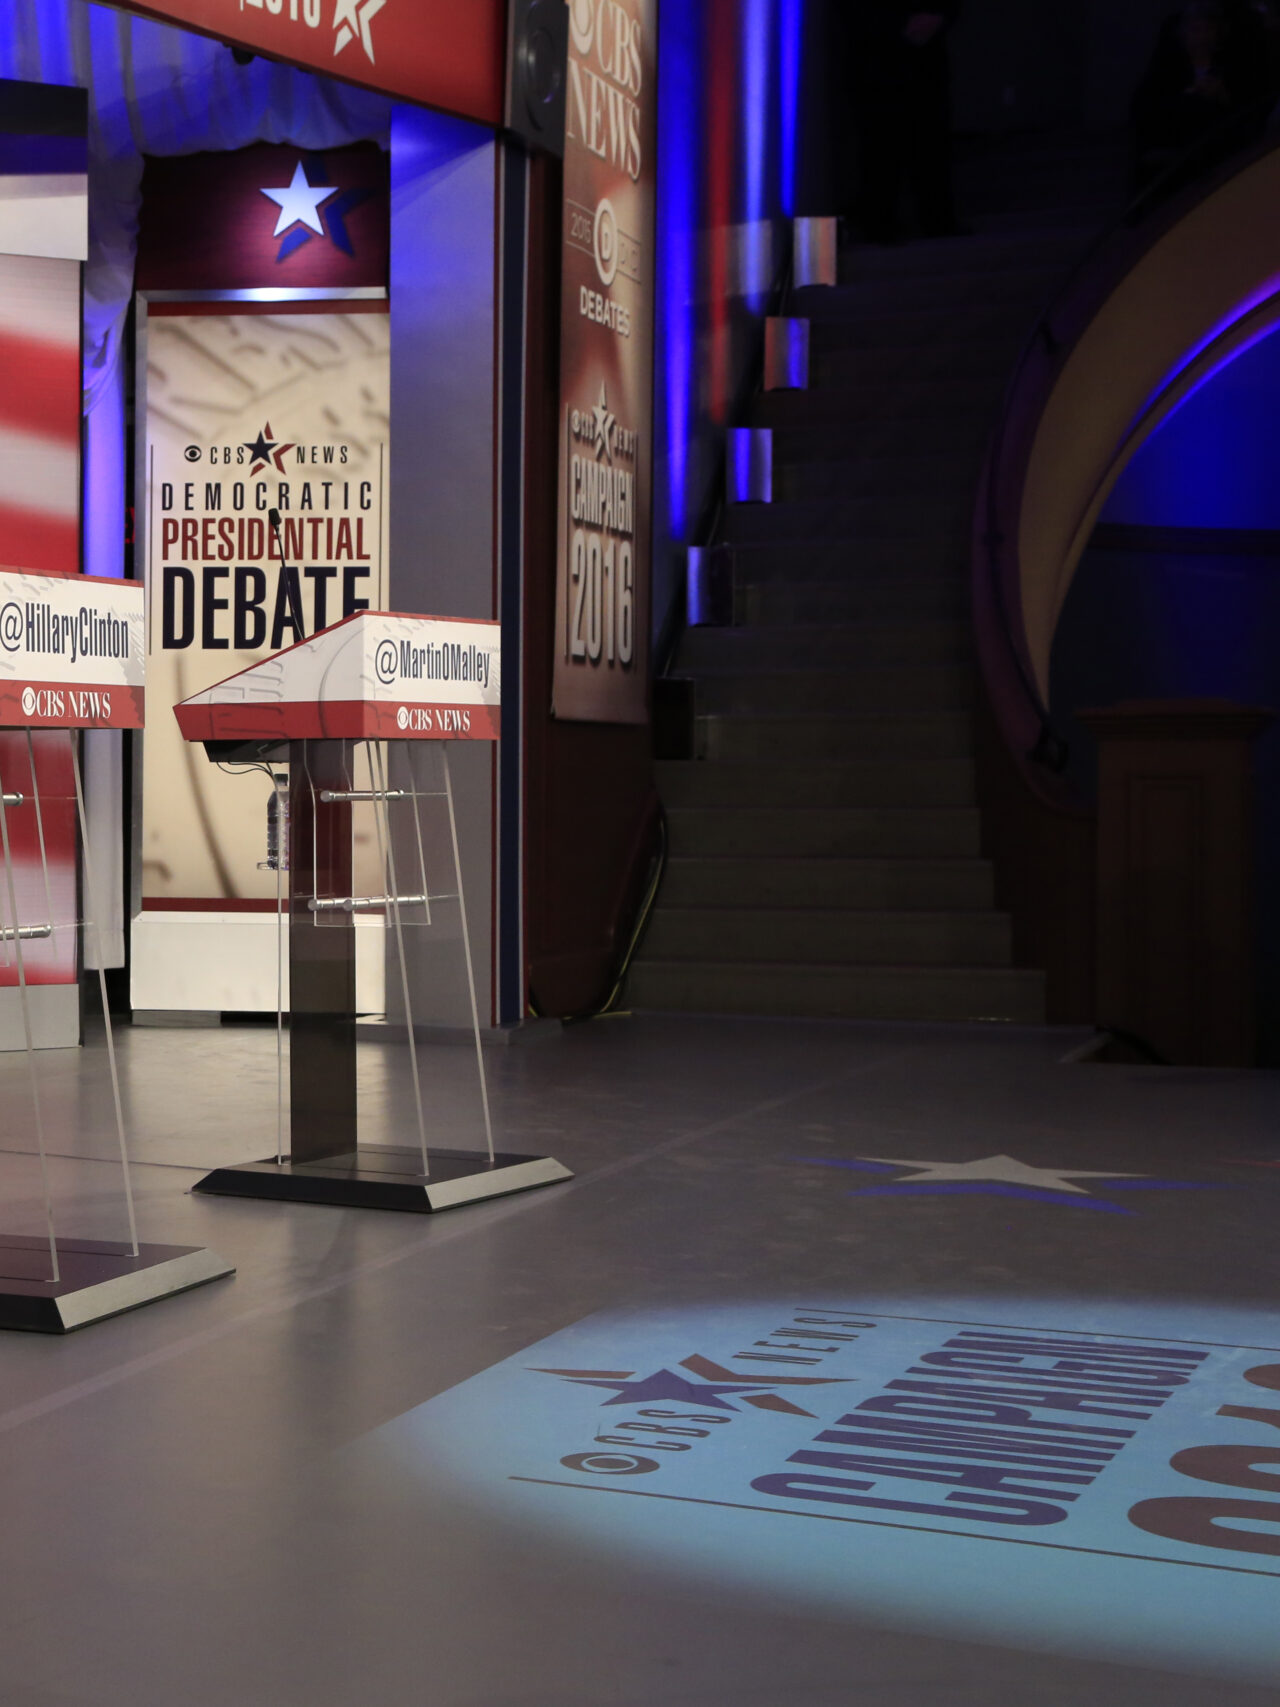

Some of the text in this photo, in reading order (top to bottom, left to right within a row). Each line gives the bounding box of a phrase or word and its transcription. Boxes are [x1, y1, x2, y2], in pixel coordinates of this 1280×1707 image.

[595, 0, 642, 97] CBS
[567, 57, 641, 181] NEWS
[580, 285, 631, 338] DEBATES
[210, 445, 348, 464] CBS NEWS
[161, 481, 371, 511] DEMOCRATIC
[571, 453, 633, 533] CAMPAIGN
[162, 517, 371, 561] PRESIDENTIAL
[162, 566, 370, 650] DEBATE
[571, 528, 633, 663] 2016
[0, 602, 129, 664] @HillaryClinton
[375, 639, 490, 689] @MartinOMalley
[36, 690, 111, 719] CBS NEWS
[408, 708, 471, 732] CBS NEWS
[593, 1316, 878, 1452] CBS NEWS
[750, 1330, 1210, 1527] CAMPAIGN
